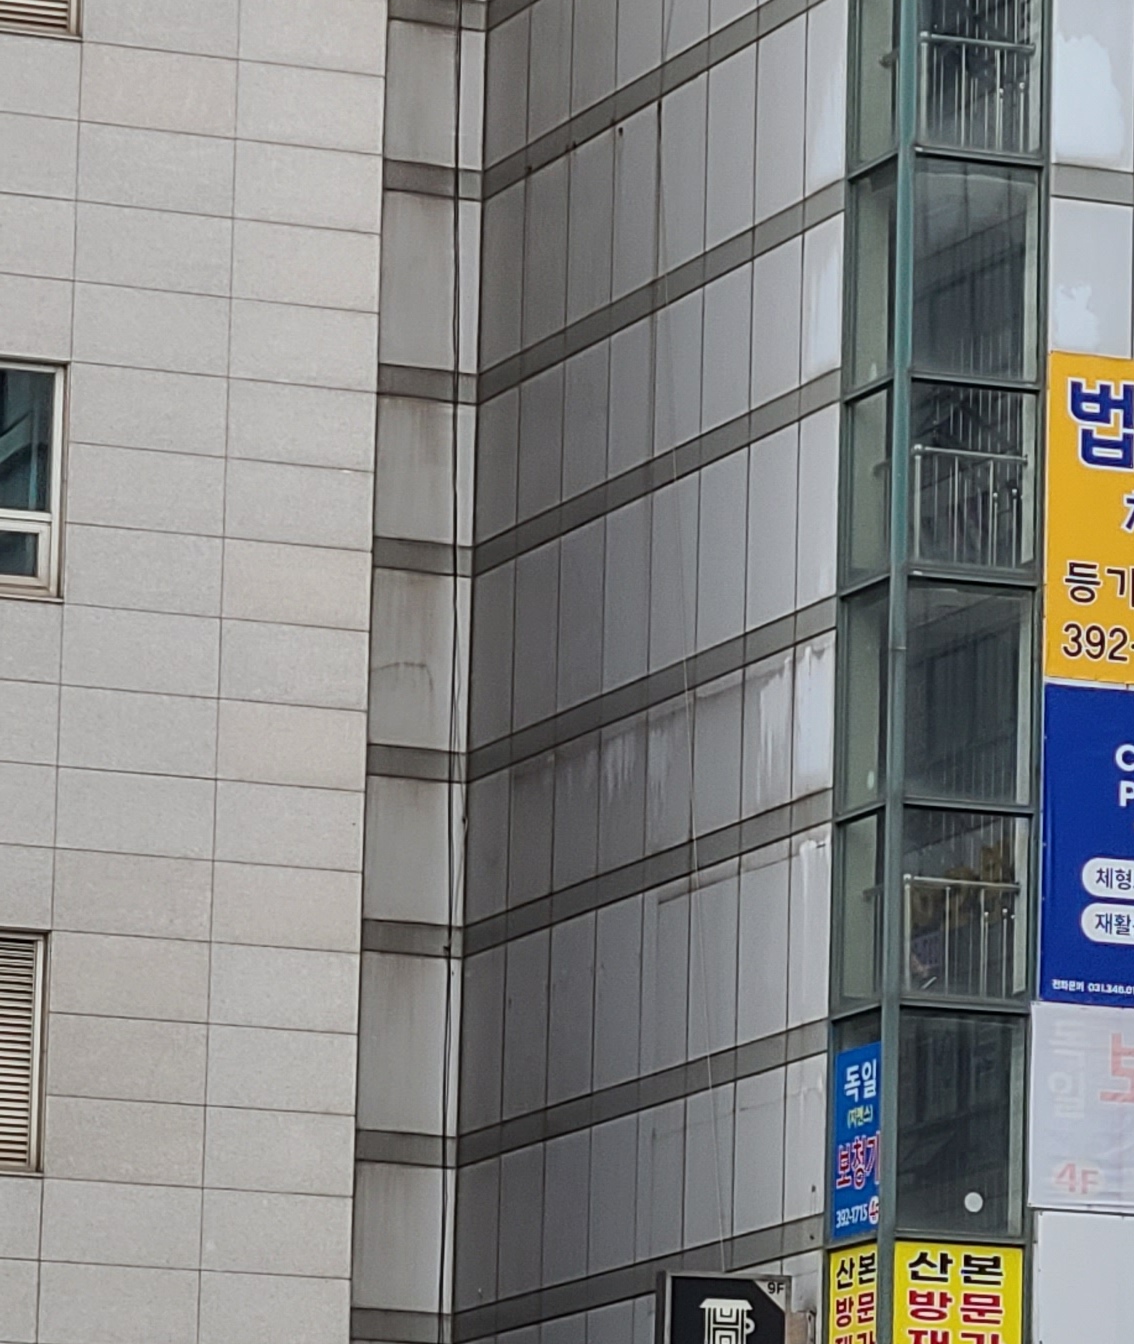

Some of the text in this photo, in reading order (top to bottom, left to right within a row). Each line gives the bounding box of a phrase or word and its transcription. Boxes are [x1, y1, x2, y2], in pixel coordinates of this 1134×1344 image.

[844, 1058, 878, 1102] 독일
[835, 1130, 880, 1190] 보청기
[1054, 1162, 1100, 1195] 4F
[835, 1251, 877, 1289] 산본
[908, 1250, 1004, 1287] 산본
[767, 1281, 785, 1295] 9F
[835, 1290, 875, 1329] 방문
[908, 1289, 1004, 1325] 방문
